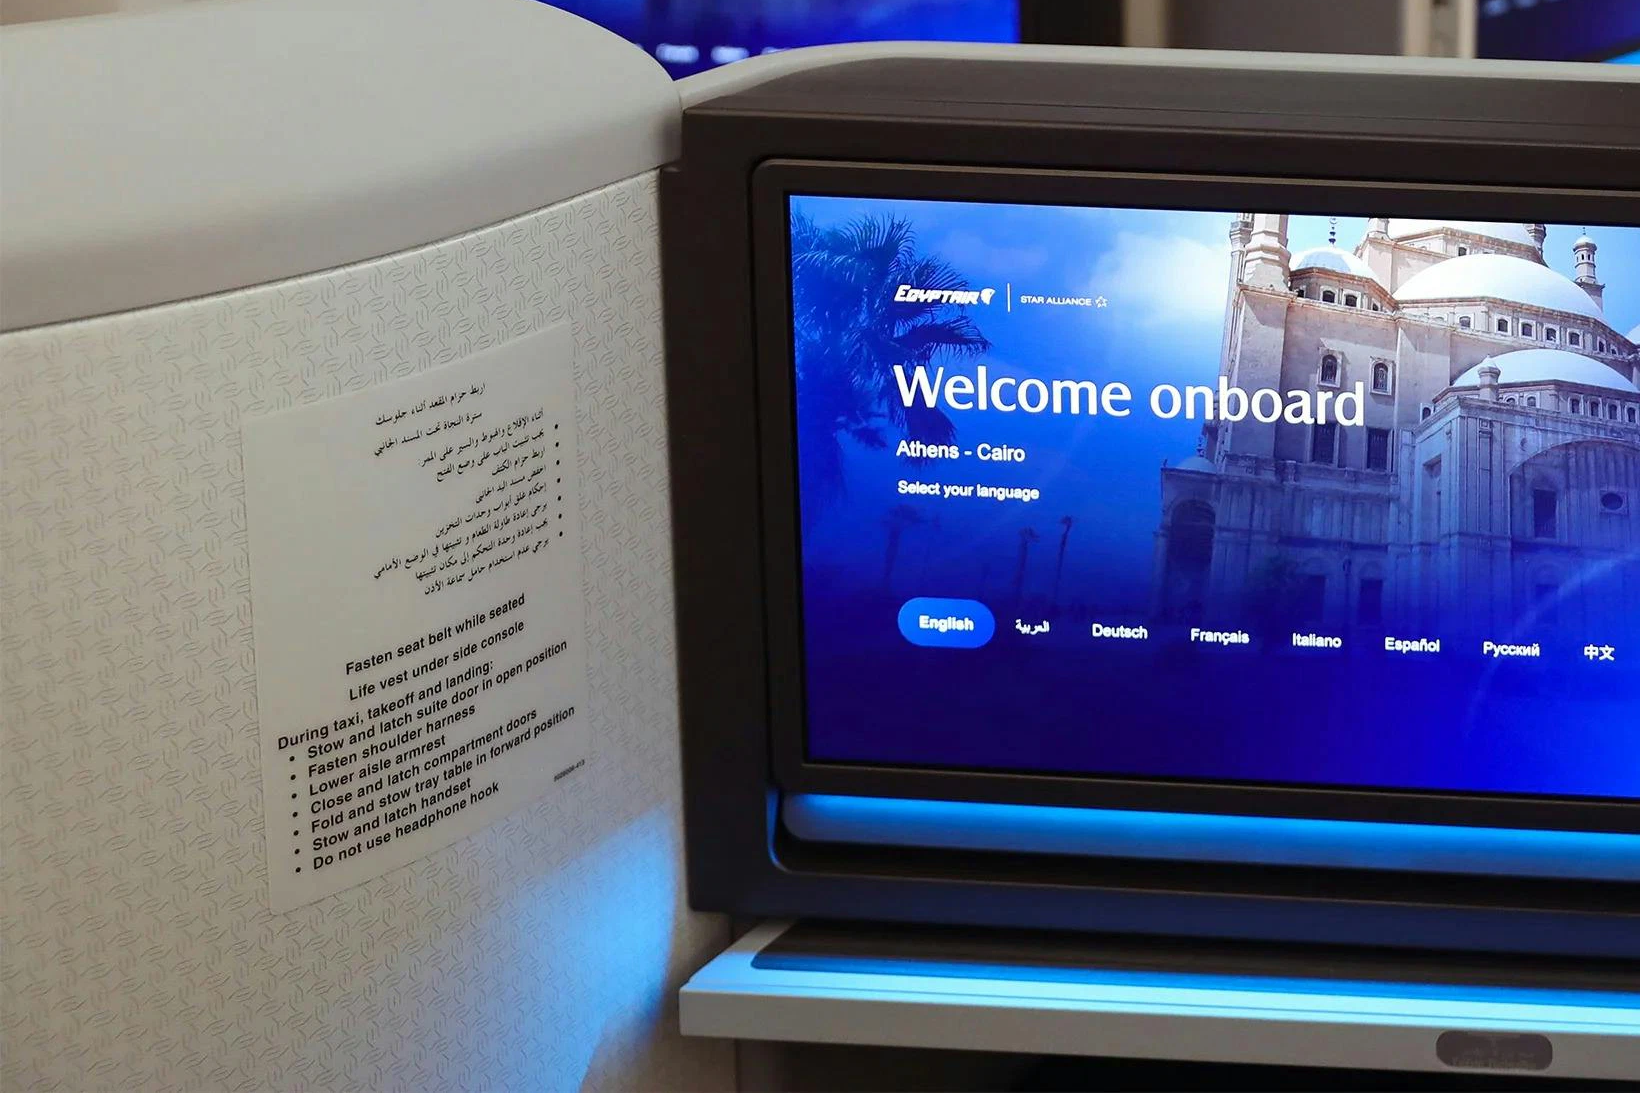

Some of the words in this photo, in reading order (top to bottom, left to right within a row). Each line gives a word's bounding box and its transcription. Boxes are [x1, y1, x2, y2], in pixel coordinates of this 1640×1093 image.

[894, 284, 979, 305] EGYPTAIR
[1020, 295, 1044, 305] STAR
[1046, 296, 1092, 306] ALLIANCE
[893, 365, 1131, 416] Welcome
[1151, 377, 1363, 425] onboard
[896, 440, 959, 459] Athens
[977, 443, 1025, 462] Cairo
[898, 480, 940, 495] Select
[943, 485, 974, 498] your
[977, 484, 1039, 502] language
[346, 651, 392, 675] Fasten
[397, 637, 425, 657] seat
[429, 627, 452, 645] belt
[455, 614, 486, 634] while
[490, 593, 524, 619] seated
[919, 615, 974, 632] English
[1016, 619, 1049, 635] العربية
[1092, 624, 1148, 639] Deutsch
[1191, 628, 1249, 645] Français
[1293, 633, 1342, 648] Italiano
[1385, 637, 1440, 653] Español
[1483, 642, 1540, 657] Русский
[1584, 644, 1614, 660] 中文
[350, 683, 375, 701] Life
[380, 670, 408, 689] vest
[412, 655, 449, 677] under
[453, 643, 478, 661] side
[481, 622, 524, 649] console
[278, 725, 328, 750] During
[334, 712, 363, 731] taxi,
[368, 691, 415, 719] takeoff
[418, 681, 442, 701] and
[446, 661, 492, 689] landing:
[308, 739, 344, 759] Stow
[349, 725, 375, 745] and
[380, 713, 412, 734] latch
[417, 699, 448, 719] suite
[452, 685, 479, 705] door
[482, 679, 492, 691] in
[496, 664, 522, 684] open
[526, 641, 566, 672] position
[309, 753, 357, 777] Fasten
[362, 728, 422, 759] shoulder
[426, 705, 475, 734] harness
[310, 772, 354, 796] Lower
[359, 759, 391, 779] aisle
[396, 735, 445, 765] armrest
[311, 793, 352, 814] Close
[358, 778, 382, 798] and
[388, 765, 420, 786] latch
[424, 725, 503, 771] compartment
[506, 710, 536, 733] doors
[312, 811, 343, 833] Fold
[348, 799, 374, 819] and
[379, 787, 411, 807] stow
[415, 775, 439, 793] tray
[443, 761, 472, 781] table
[476, 753, 486, 765] in
[490, 727, 530, 759] forward
[534, 707, 574, 739] position
[313, 830, 349, 851] Stow
[354, 816, 379, 836] and
[385, 803, 416, 824] latch
[421, 777, 470, 809] handset
[314, 855, 333, 869] Do
[339, 842, 362, 861] not
[366, 833, 391, 849] use
[396, 799, 466, 838] headphone
[470, 782, 498, 805] hook
